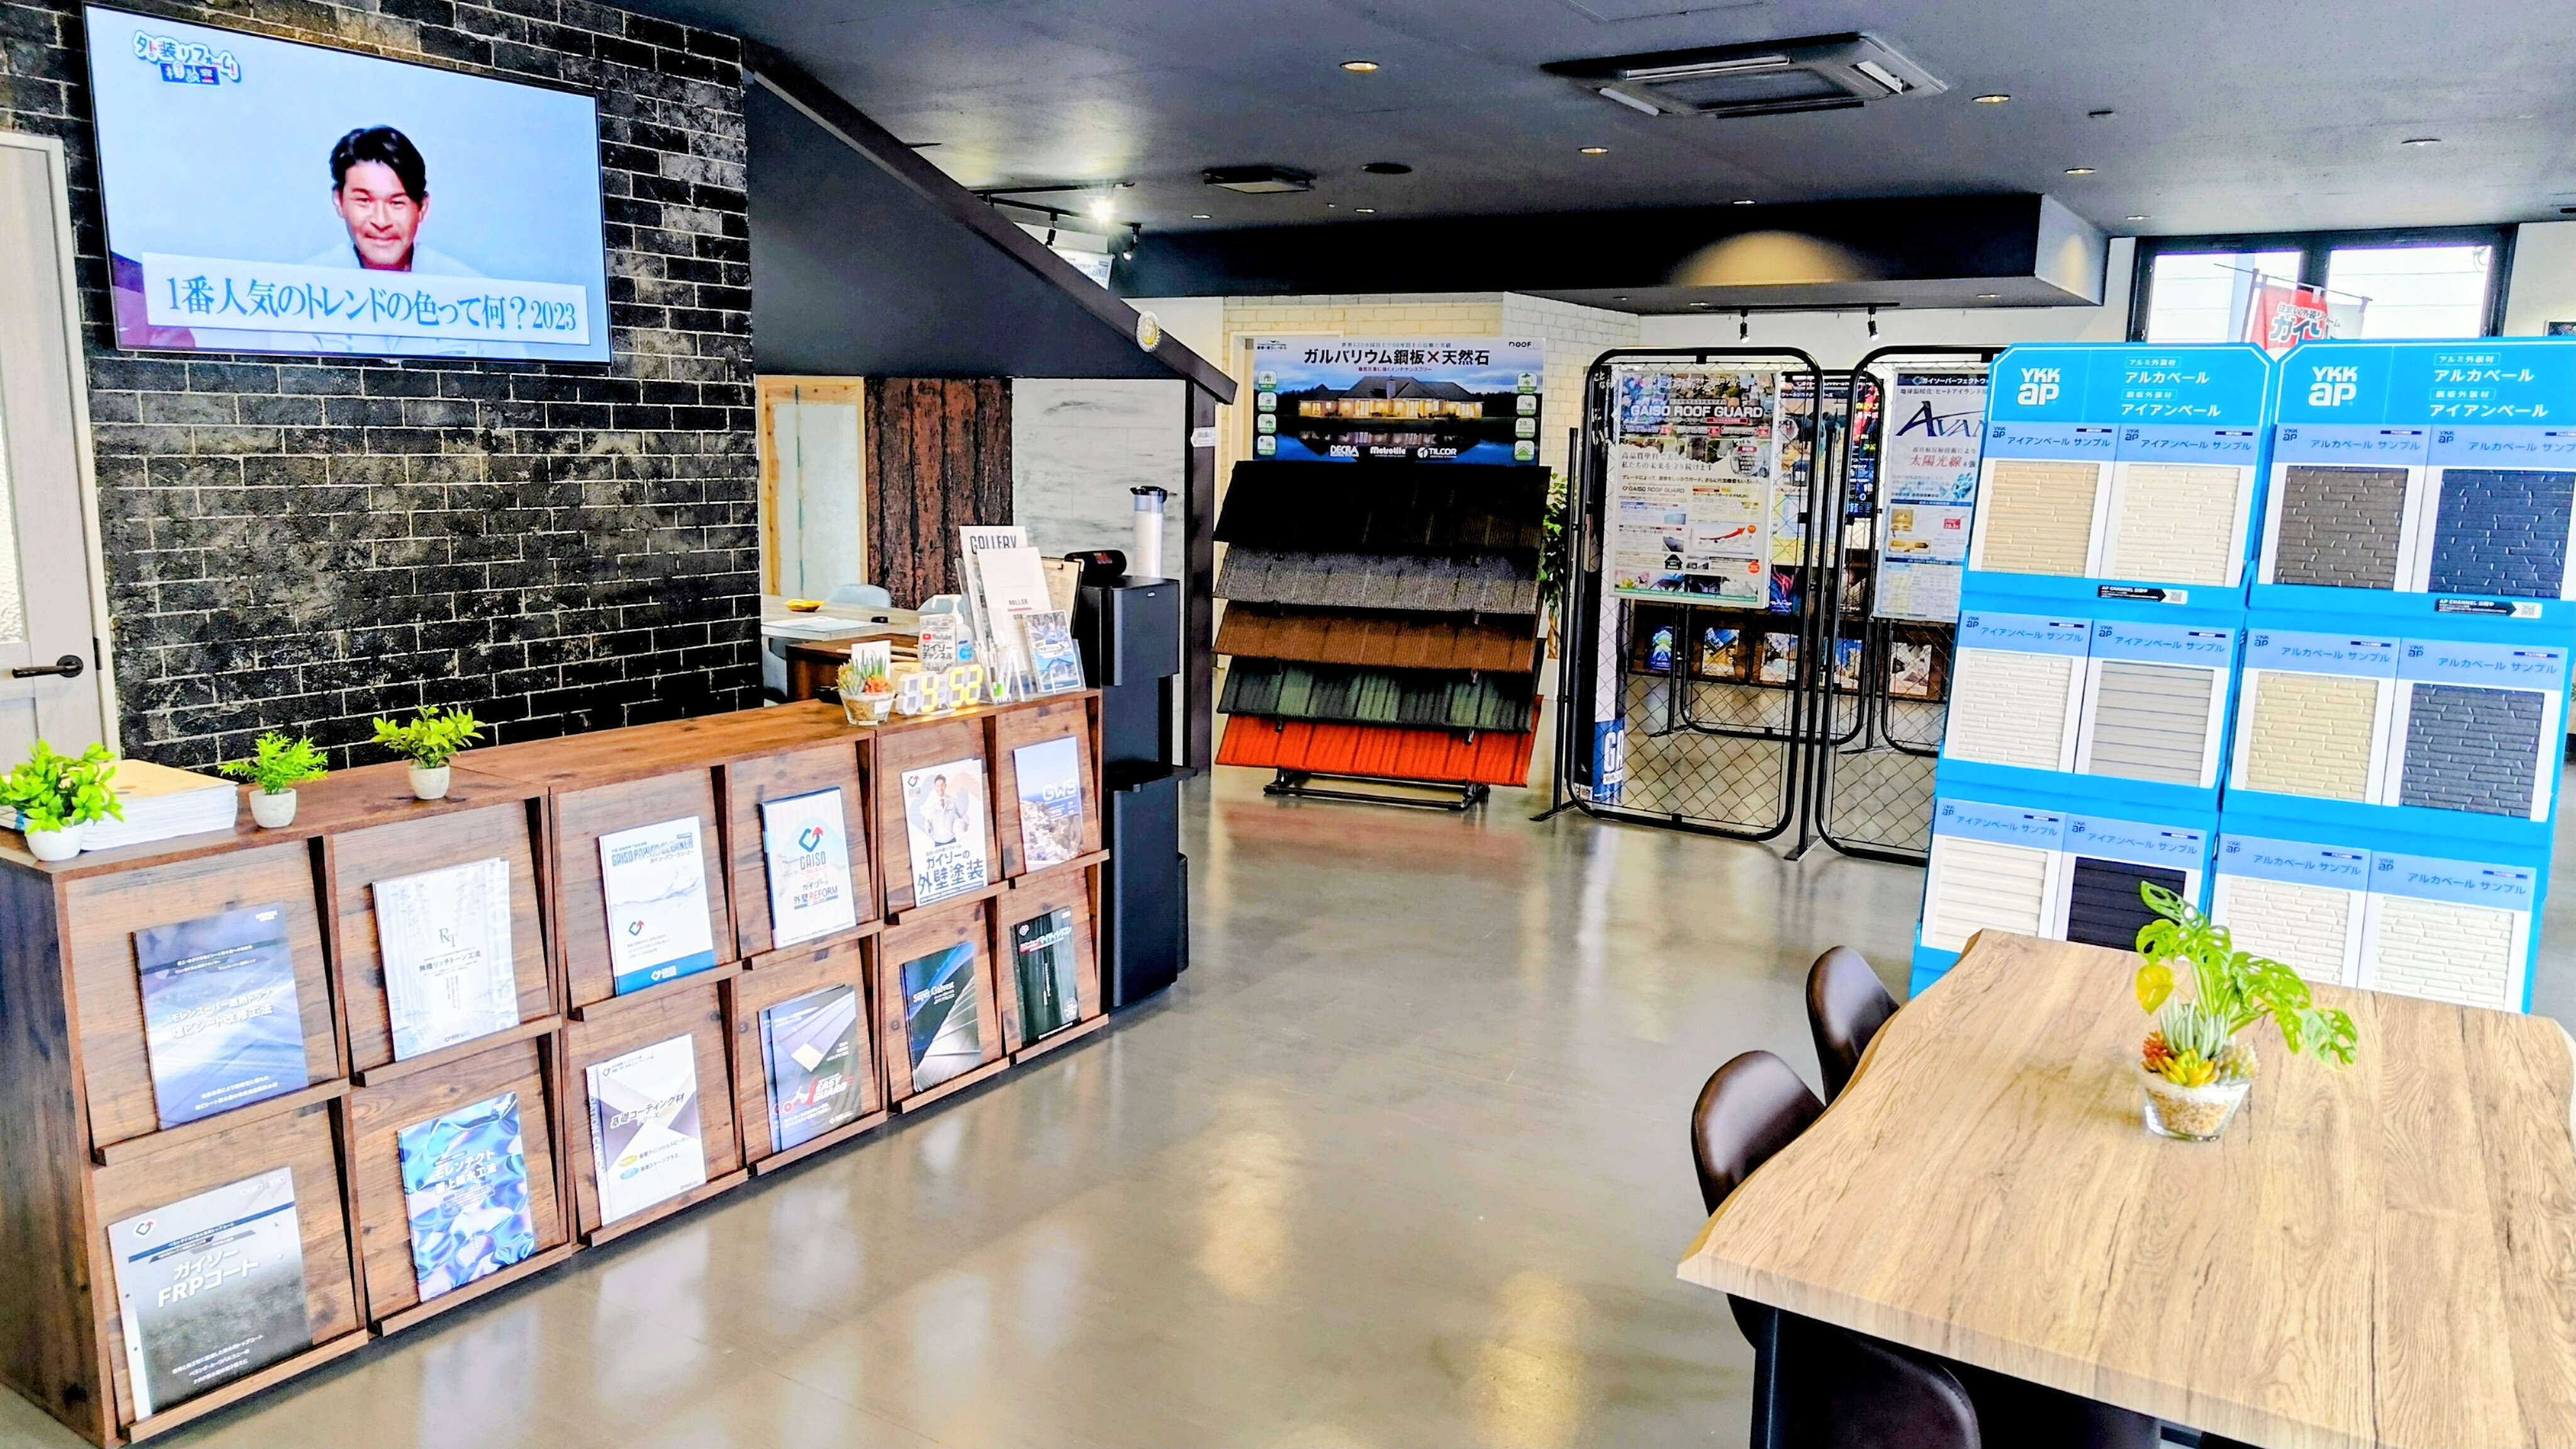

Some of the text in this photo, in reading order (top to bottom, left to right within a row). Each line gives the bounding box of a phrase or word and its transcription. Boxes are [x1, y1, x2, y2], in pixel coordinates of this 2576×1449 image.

[1304, 348, 1491, 366] ガルバリウム鋼板×天然石
[2128, 358, 2176, 367] アルミ外装材
[2438, 355, 2495, 364] アルミ外装材
[2021, 368, 2060, 383] YKK
[2124, 371, 2210, 384] アルカベール
[2312, 366, 2358, 382] YKK
[2434, 369, 2534, 382] アルカベール
[2018, 383, 2060, 406] ap
[2308, 383, 2357, 406] ap
[1630, 405, 1763, 418] GAISO ROOF GUARD
[2121, 404, 2221, 418] アイアンベール
[2429, 404, 2548, 418] アイアンベール
[2007, 436, 2111, 448] アイアンベール サンプル
[2141, 439, 2251, 451] アイアンベール サンプル
[2311, 440, 2420, 451] アルカベール サンプル
[2468, 441, 2537, 452] アルカベール
[1330, 445, 1359, 456] DECRA
[1370, 446, 1406, 455] Metrotile
[1429, 447, 1457, 455] TILCOR
[1981, 627, 2083, 642] アイアンベール サンプル
[923, 644, 952, 652] ガイソー
[2115, 636, 2225, 653] アイアンベール サンプル
[2282, 647, 2390, 662] アルカベール サンプル
[2438, 657, 2557, 674] アルカベール サンプル
[1042, 779, 1077, 801] GWS
[1957, 816, 2058, 836] アイアンベール サンプル
[2087, 832, 2197, 855] アイアンベール サンプル
[800, 850, 826, 870] GAISO
[926, 850, 970, 870] ガイソーの
[2253, 854, 2361, 876] アルカベール サンプル
[918, 858, 984, 896] 外壁塗装
[2407, 873, 2526, 895] アルカベール サンプル
[815, 1075, 843, 1093] EASY
[174, 1248, 240, 1281] ガイソー
[158, 1258, 260, 1308] FRPコート
